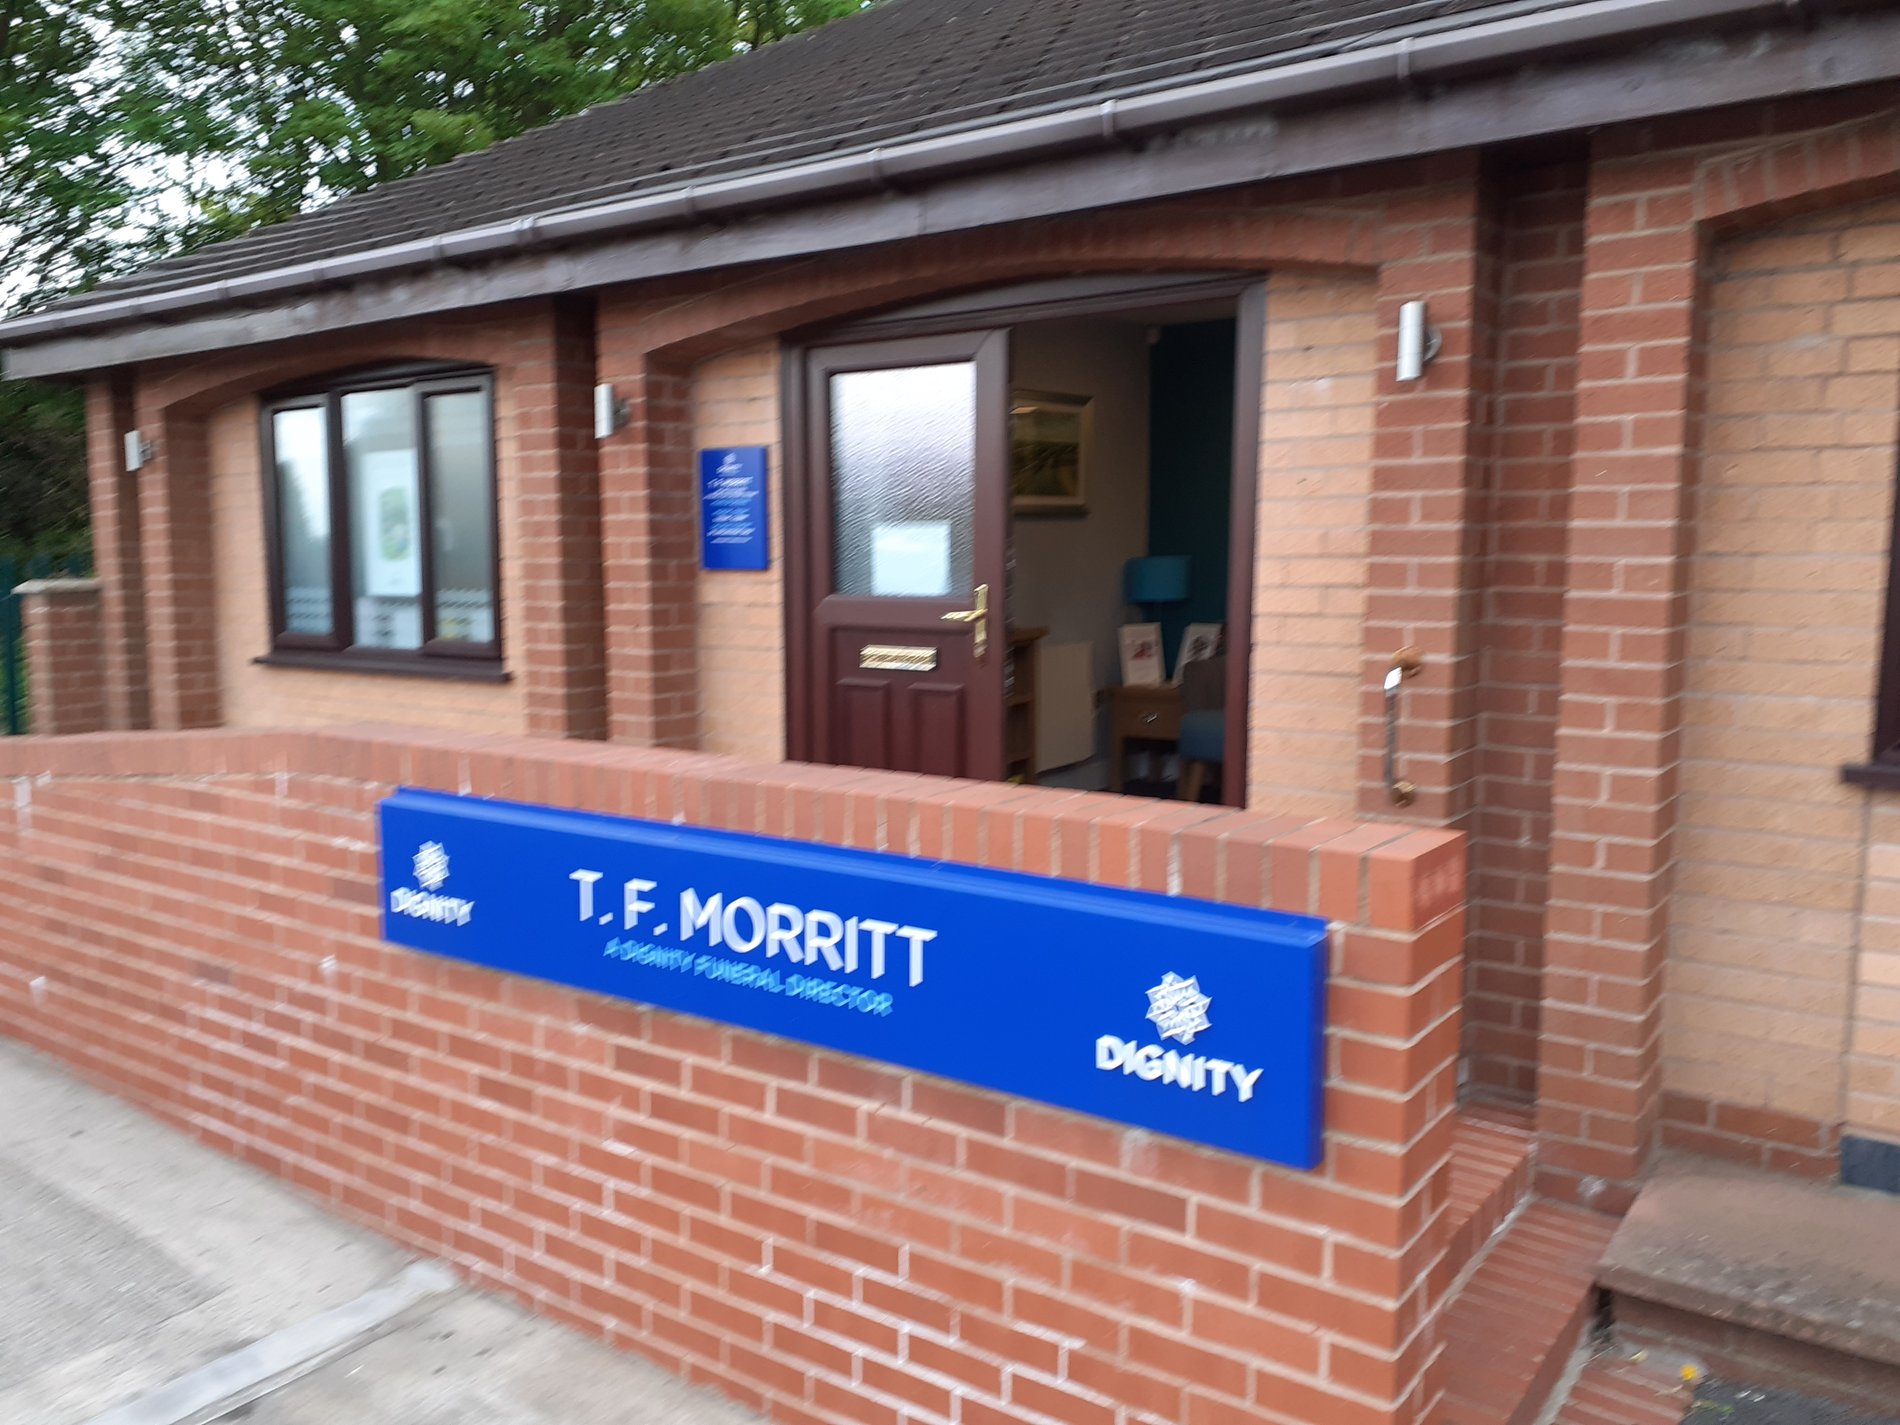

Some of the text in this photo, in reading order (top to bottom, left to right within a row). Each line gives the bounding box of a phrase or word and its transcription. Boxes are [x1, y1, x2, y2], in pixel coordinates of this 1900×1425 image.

[390, 886, 475, 927] DIGNITY
[569, 868, 938, 988] T. F. MORRITT
[620, 939, 695, 973] DIGNITY
[694, 954, 786, 993] FUNERAL
[785, 973, 893, 1017] DIRECTOR
[1095, 1034, 1264, 1102] DIGNITY
